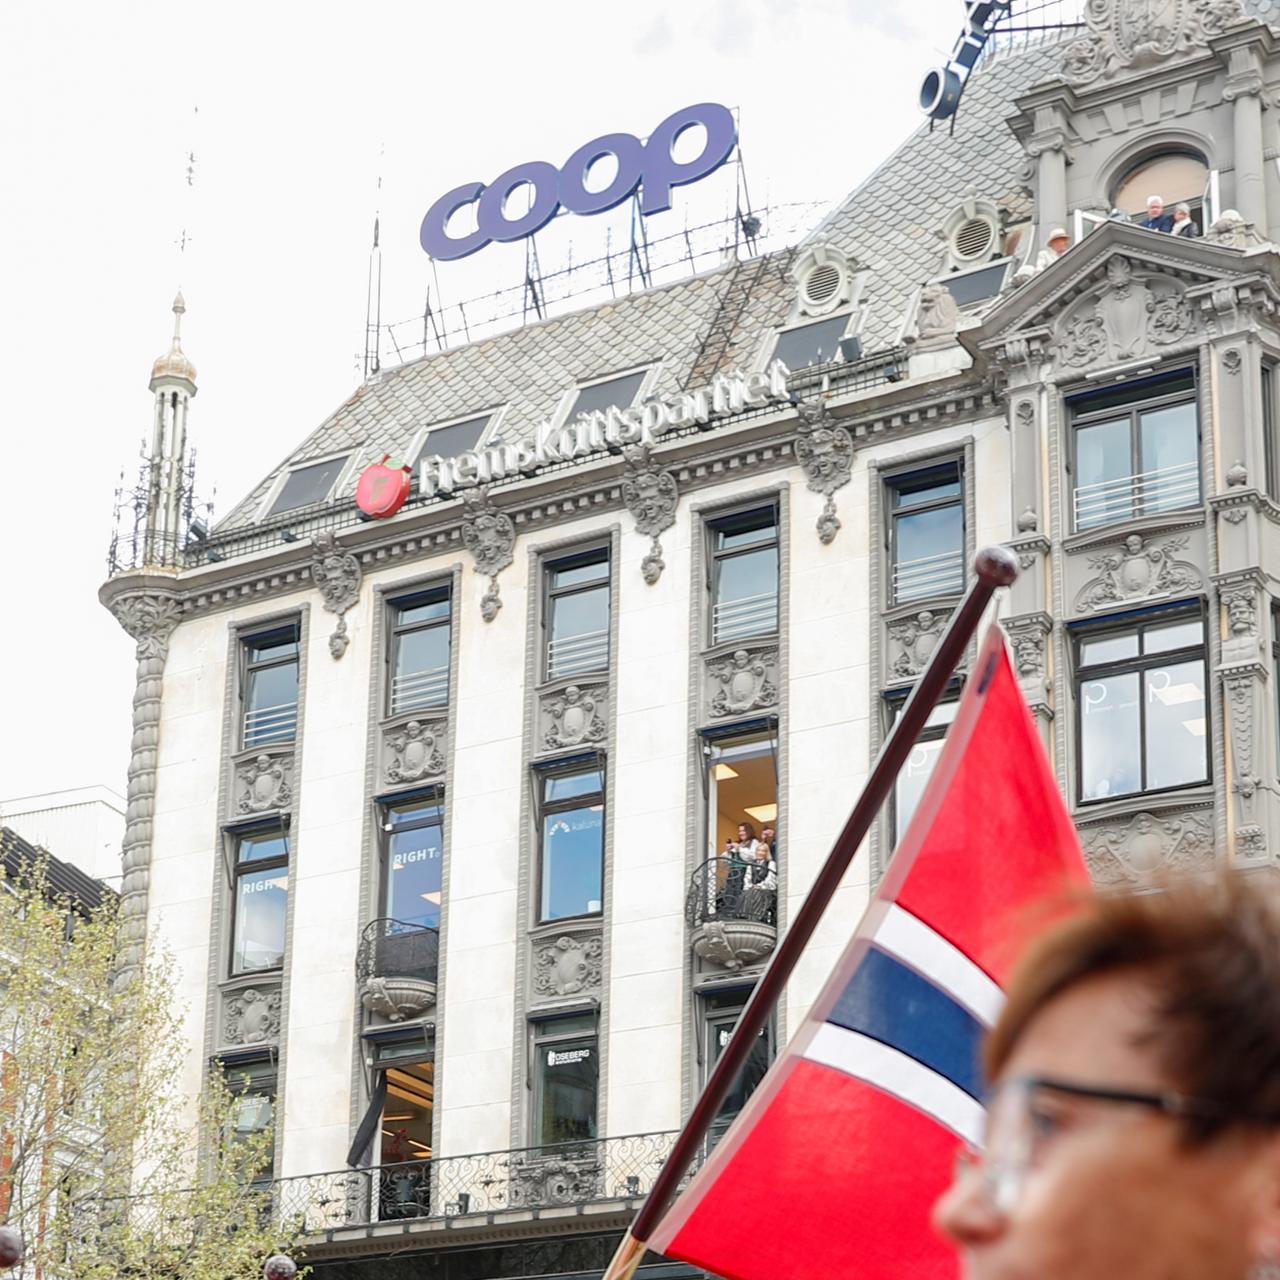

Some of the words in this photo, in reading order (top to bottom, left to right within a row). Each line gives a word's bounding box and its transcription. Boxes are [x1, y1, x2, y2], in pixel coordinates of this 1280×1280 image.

[420, 102, 737, 262] coop
[418, 356, 792, 499] Fremskrittspartiet
[242, 880, 274, 896] RIGH
[392, 847, 437, 865] RIGHT
